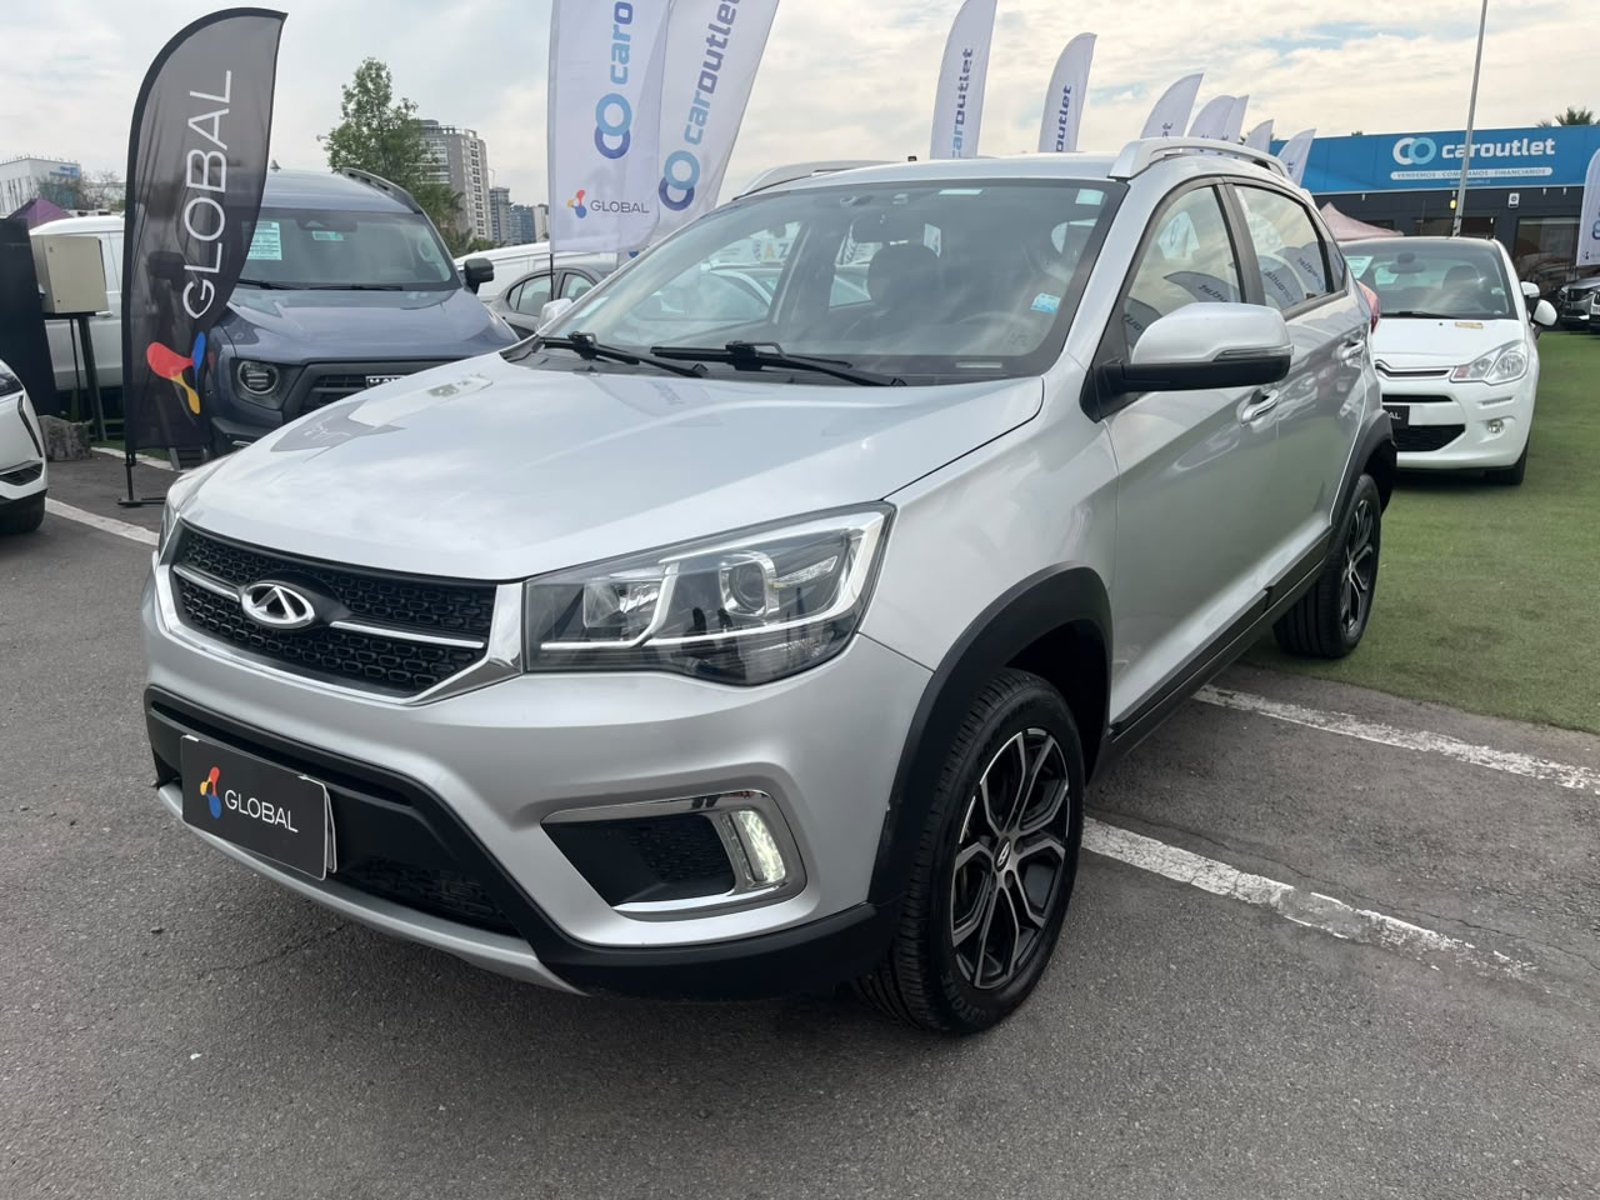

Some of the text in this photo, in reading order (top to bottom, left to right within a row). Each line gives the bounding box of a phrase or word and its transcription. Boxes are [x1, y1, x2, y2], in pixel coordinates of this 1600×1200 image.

[684, 0, 740, 145] caroutle
[1441, 138, 1556, 159] caroutlet
[183, 70, 232, 319] GLOBAL
[590, 200, 650, 214] GLOBAL
[224, 789, 299, 834] GLOBAL
